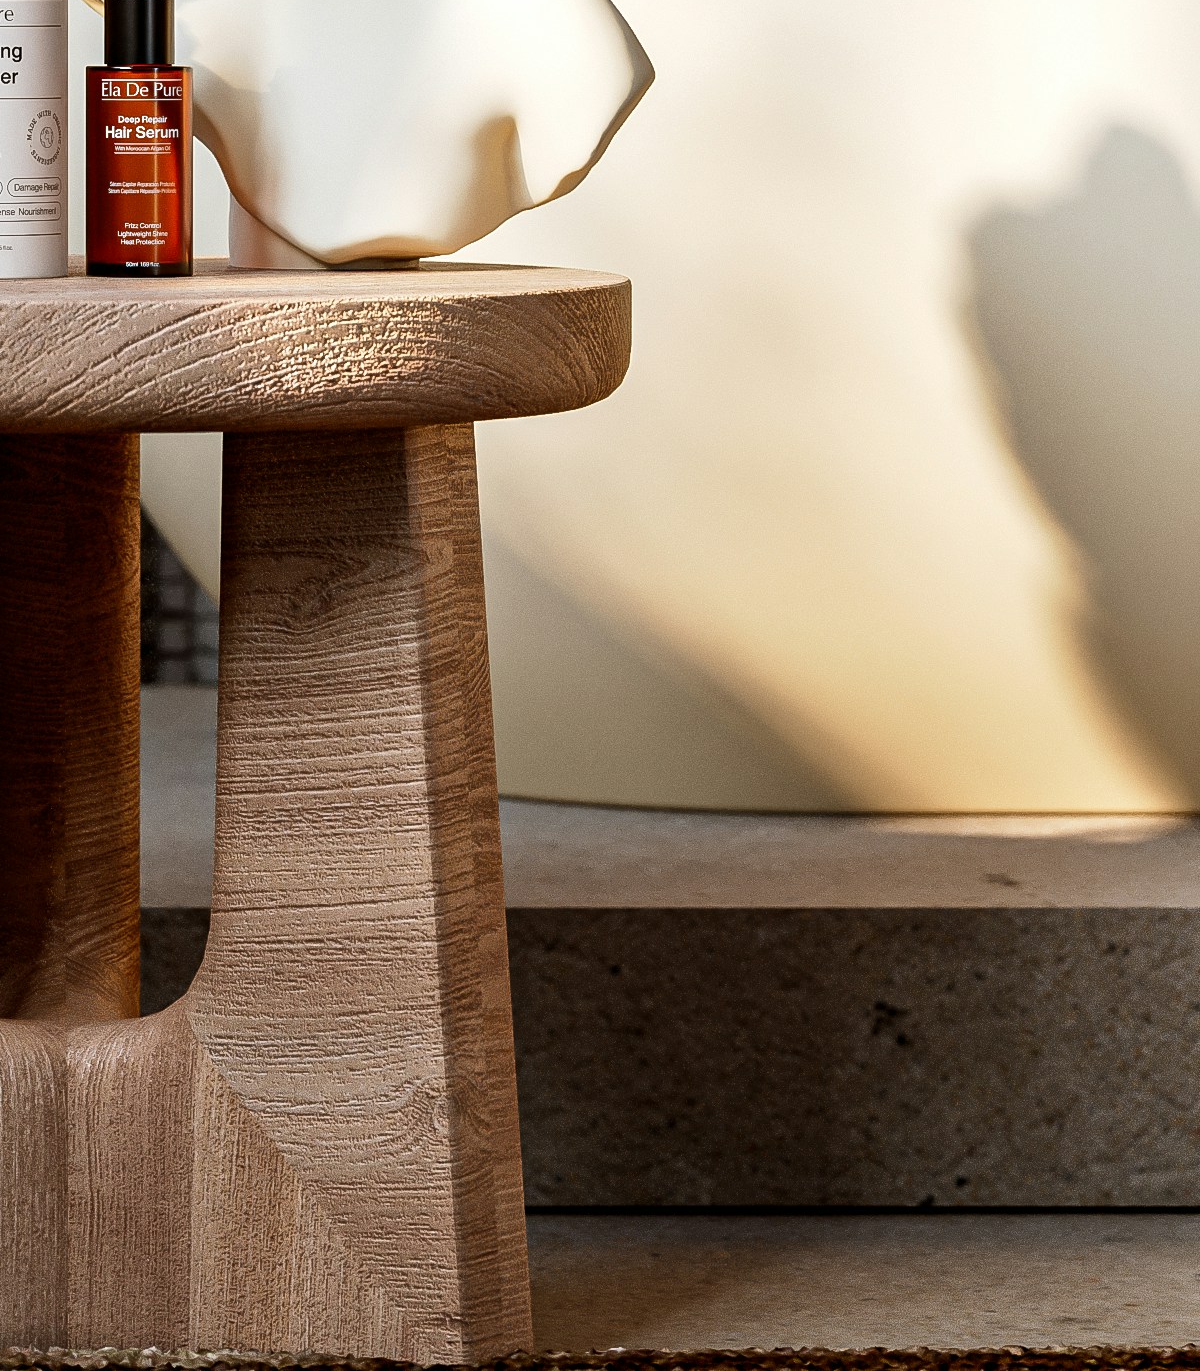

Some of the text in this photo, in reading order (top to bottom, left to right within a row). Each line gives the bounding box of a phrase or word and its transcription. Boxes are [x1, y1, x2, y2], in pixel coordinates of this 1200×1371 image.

[102, 81, 182, 97] Ela De Pure
[118, 116, 167, 125] Deep Repair
[105, 126, 179, 139] Hair Serum
[14, 183, 43, 194] Damage
[18, 207, 56, 216] Nourishment
